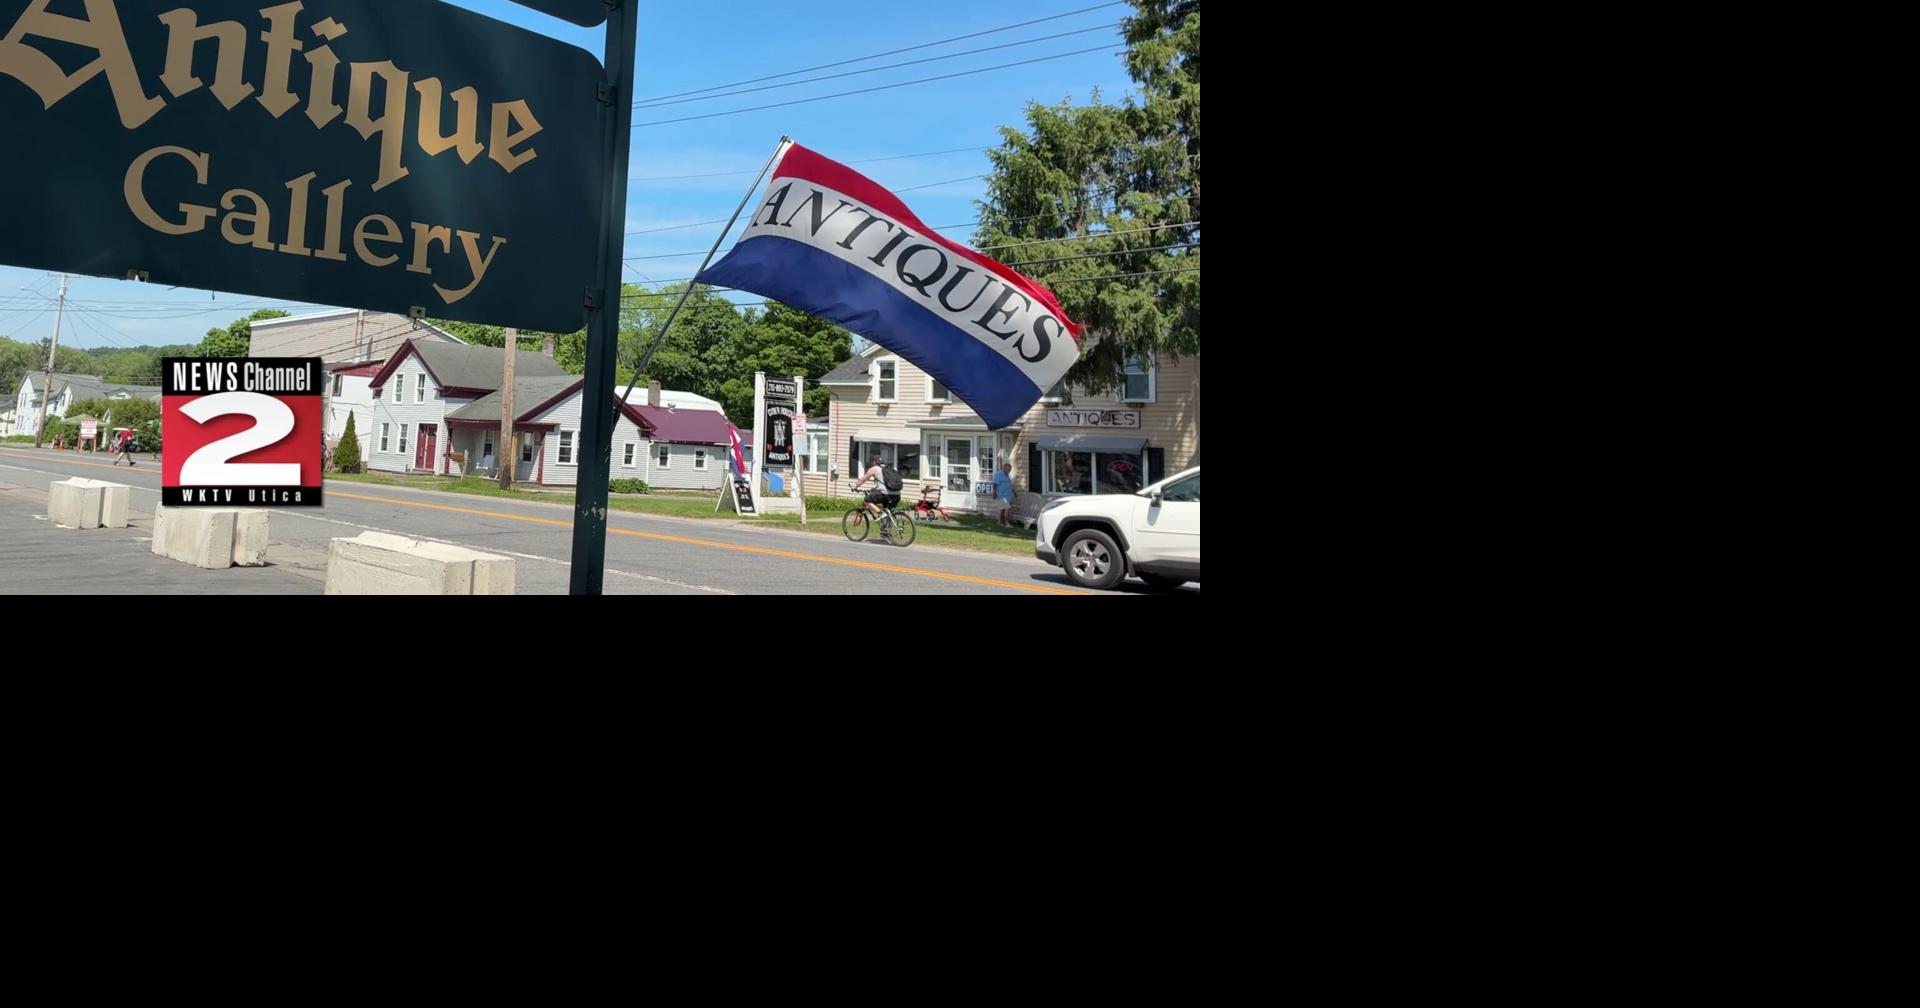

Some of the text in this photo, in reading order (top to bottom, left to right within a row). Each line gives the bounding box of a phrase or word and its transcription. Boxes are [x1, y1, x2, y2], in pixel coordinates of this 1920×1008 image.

[0, 0, 543, 192] Antique
[123, 145, 507, 304] Gallery
[752, 182, 1065, 363] ANTIQUES
[976, 482, 993, 494] OPE
